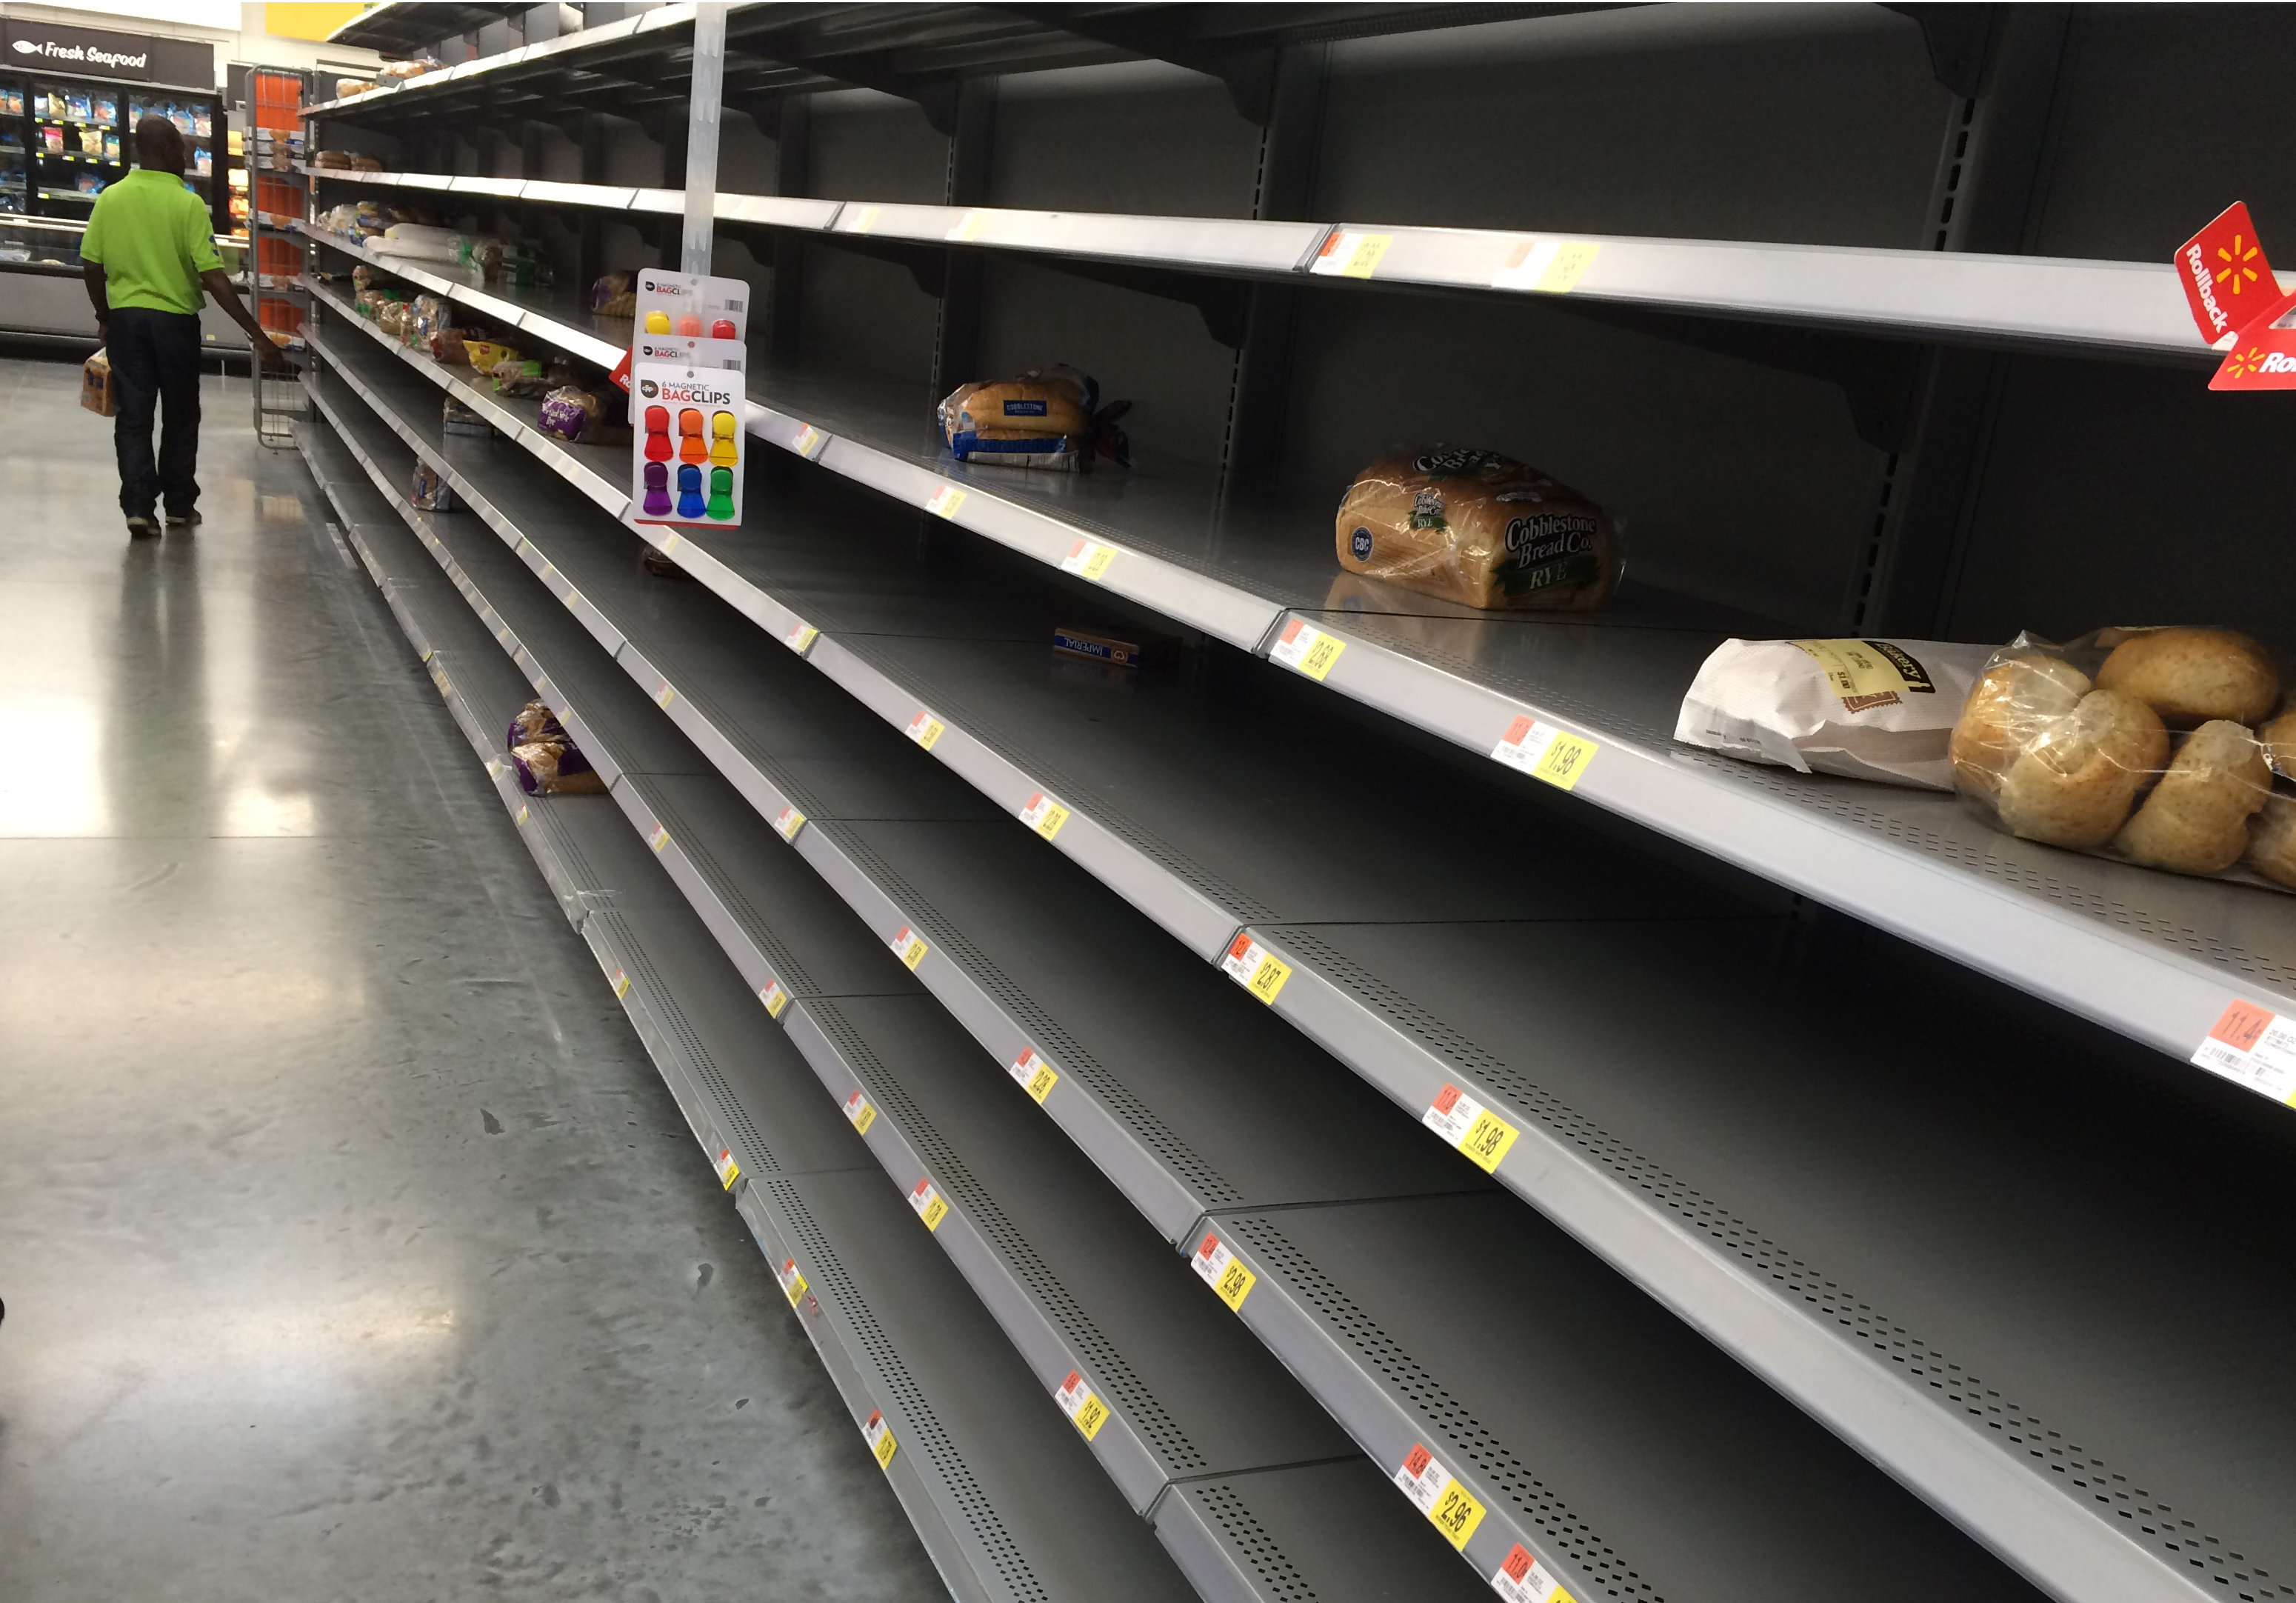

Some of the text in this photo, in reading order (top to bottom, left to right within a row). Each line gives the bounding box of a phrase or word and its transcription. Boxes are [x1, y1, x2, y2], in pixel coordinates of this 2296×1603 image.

[45, 41, 147, 68] Fresh Seafood
[2186, 243, 2228, 333] Rollback
[661, 387, 730, 404] BAGCLIPS
[669, 381, 710, 391] MAGNETIC
[1418, 518, 1433, 528] RYE
[1507, 516, 1596, 550] Cobblestone
[1355, 536, 1369, 552] CBC
[1518, 532, 1592, 569] Bread Co.
[1529, 561, 1568, 590] RYE
[1064, 637, 1104, 656] IMPERIAL
[1550, 741, 1582, 775] $1.98
[1256, 962, 1281, 991] $2.87
[1473, 1119, 1504, 1156] $1.98
[1223, 1265, 1246, 1297] $2.98
[1441, 1490, 1472, 1533] $2.96
